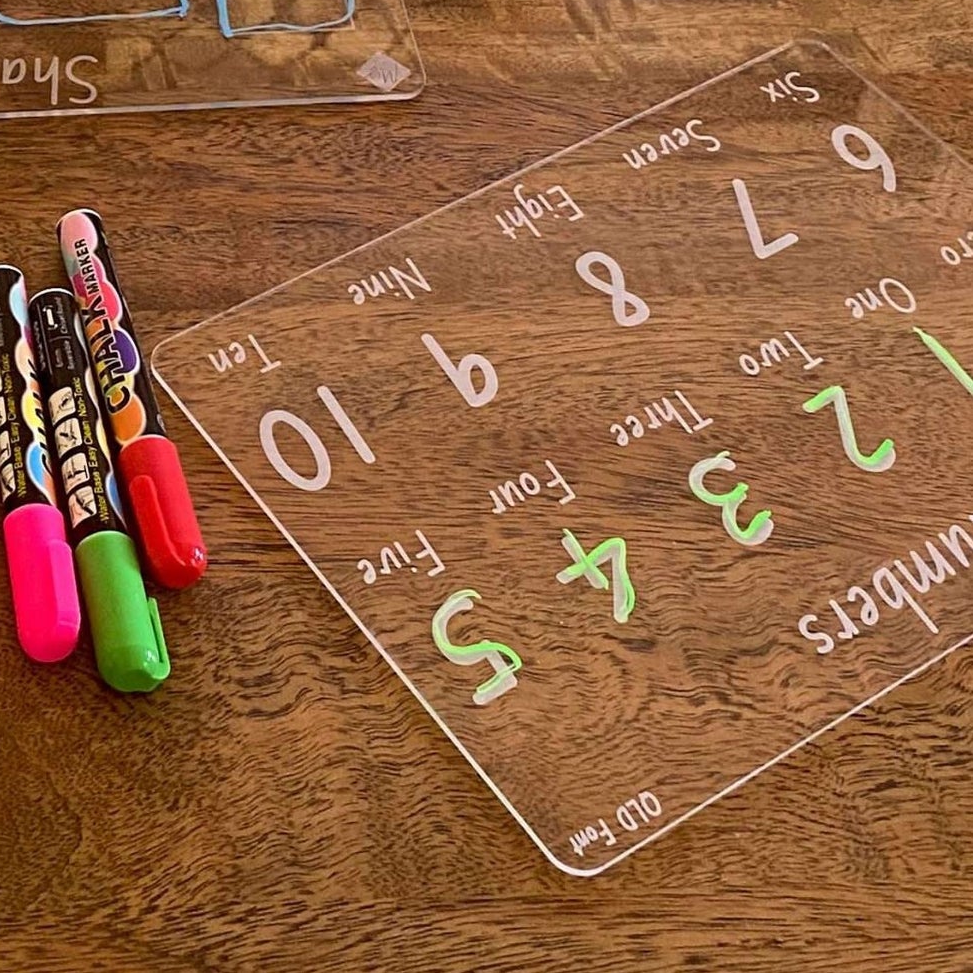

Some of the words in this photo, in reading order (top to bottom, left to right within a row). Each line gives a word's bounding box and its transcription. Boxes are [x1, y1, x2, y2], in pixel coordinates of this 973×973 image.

[759, 70, 821, 104] Six
[621, 118, 721, 171] Seven
[830, 124, 897, 193] 6
[495, 183, 585, 241] Eight
[731, 177, 800, 260] 7
[73, 237, 101, 295] MARKER
[346, 257, 433, 306] Nine
[574, 250, 651, 328] 8
[843, 277, 918, 319] One
[0, 353, 14, 394] Non-Toxic
[80, 295, 131, 414] CHALK
[207, 333, 283, 374] Ten
[420, 332, 500, 408] 9
[739, 331, 824, 376] Two
[71, 376, 88, 418] Non-Toxic
[609, 390, 714, 447] Three
[10, 421, 22, 444] Easy
[81, 420, 94, 445] Clean
[87, 446, 98, 468] Easy
[258, 384, 377, 492] 10
[802, 385, 897, 473] 2
[92, 471, 104, 494] Base
[97, 495, 110, 521] Water
[488, 459, 577, 515] Four
[688, 450, 775, 546] 3
[357, 529, 446, 585] Five
[555, 527, 636, 624] 4
[797, 513, 973, 655] umbers
[431, 588, 523, 705] 5
[568, 817, 618, 858] Font
